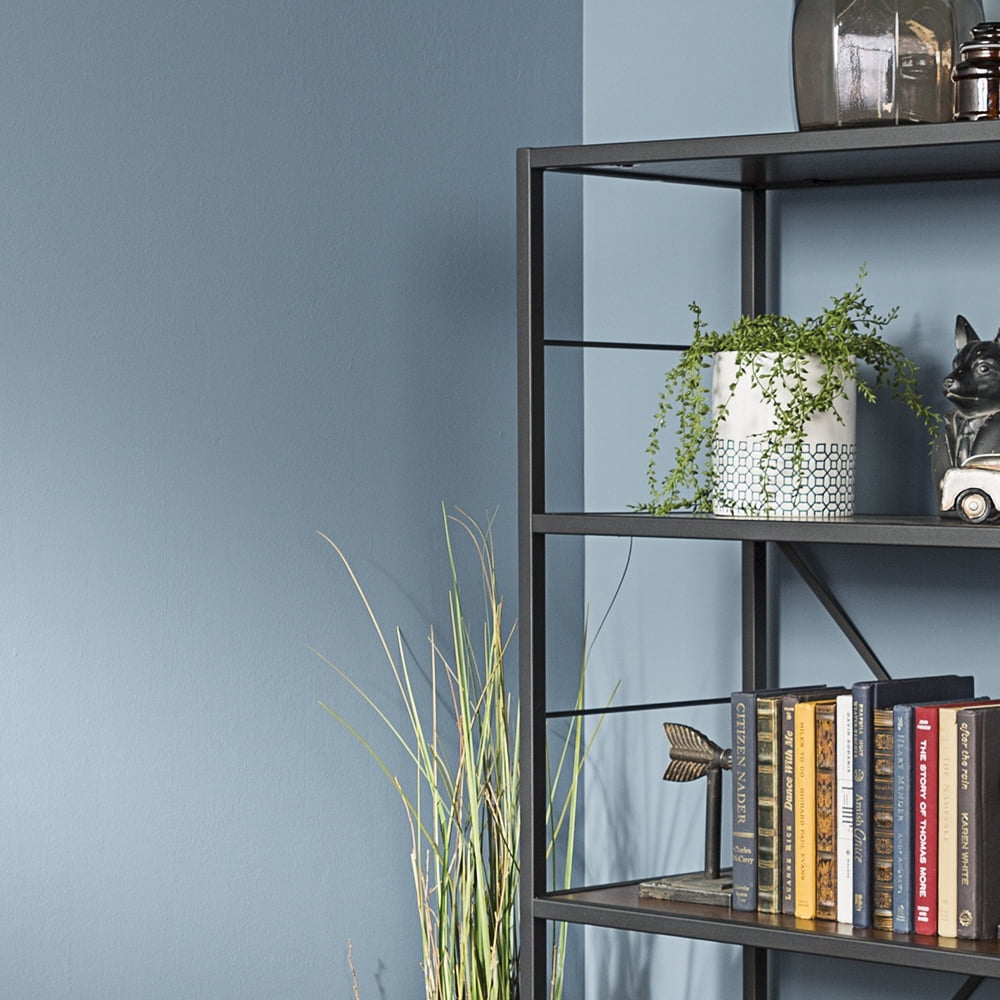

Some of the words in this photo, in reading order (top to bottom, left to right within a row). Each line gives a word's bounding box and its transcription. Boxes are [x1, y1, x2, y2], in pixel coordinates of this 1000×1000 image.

[735, 702, 746, 770] CITIZEN
[785, 730, 794, 749] Me
[960, 722, 970, 750] after
[785, 749, 794, 775] With
[799, 751, 806, 763] TO
[919, 740, 927, 762] THE
[961, 751, 970, 766] the
[799, 766, 806, 778] GO
[919, 764, 927, 799] STORY
[961, 768, 970, 790] rain
[736, 774, 747, 825] NADER
[784, 777, 794, 812] Dance
[855, 793, 864, 827] Amish
[919, 802, 927, 817] OF
[785, 825, 793, 852] RICE
[919, 820, 927, 864] THOMAS
[961, 812, 969, 849] KAREN
[853, 827, 867, 865] Grace
[919, 867, 927, 898] MORE
[961, 851, 969, 886] WHITE
